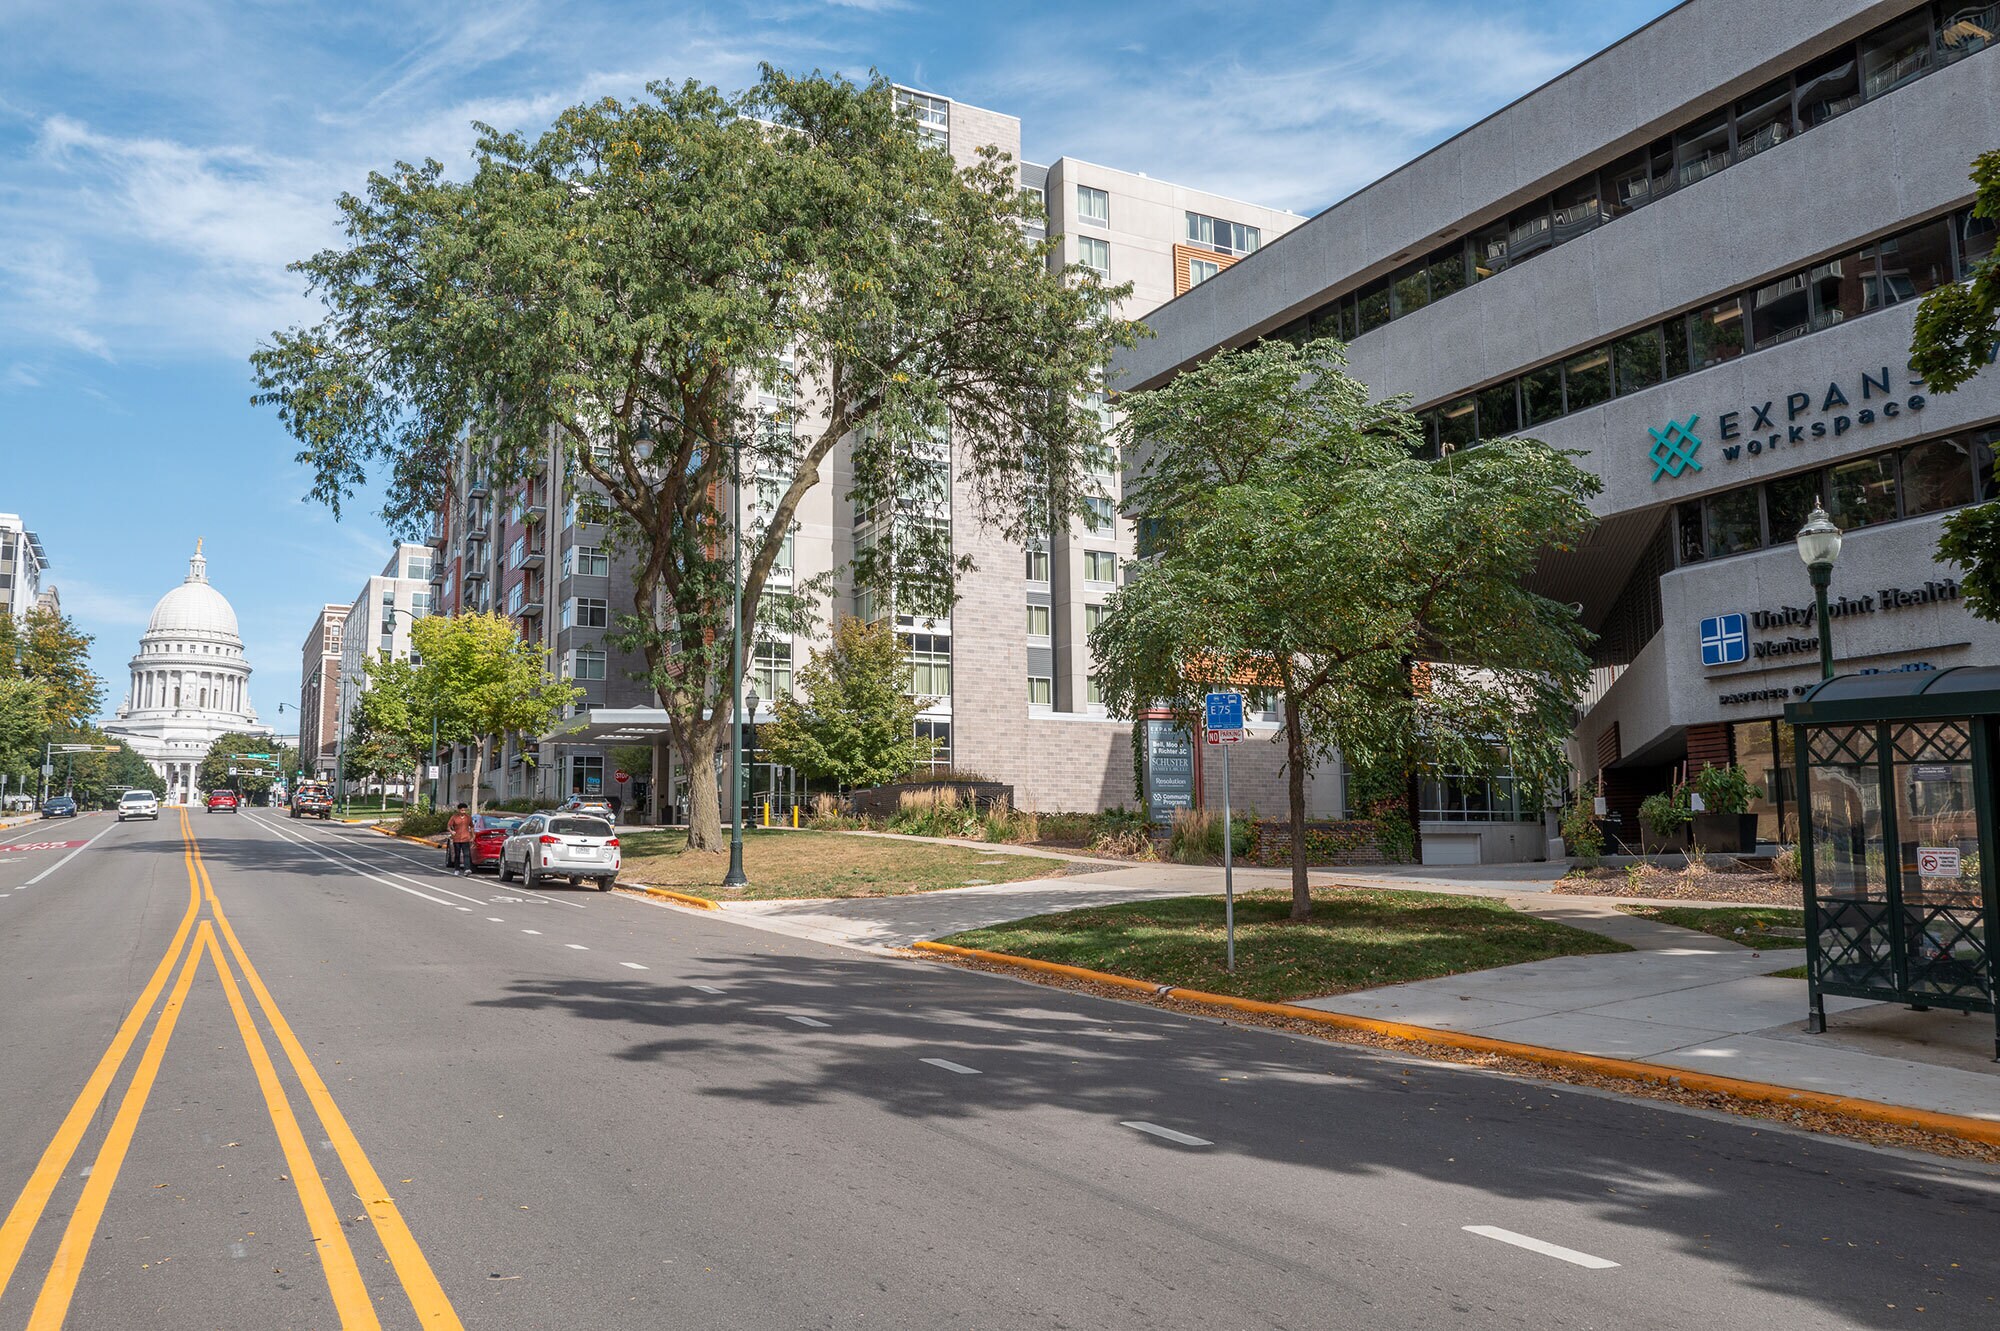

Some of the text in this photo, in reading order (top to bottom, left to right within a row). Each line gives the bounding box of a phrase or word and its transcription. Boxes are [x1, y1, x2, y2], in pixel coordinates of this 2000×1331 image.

[1722, 394, 1926, 461] workspace
[1878, 578, 1962, 610] Health
[1753, 637, 1820, 658] Meriter
[1719, 687, 1789, 705] PARTNER
[1210, 705, 1231, 715] E 75
[1209, 732, 1218, 742] NO
[1152, 757, 1188, 767] SCHUSTER
[1156, 777, 1186, 785] Resolution
[1163, 793, 1191, 801] Community
